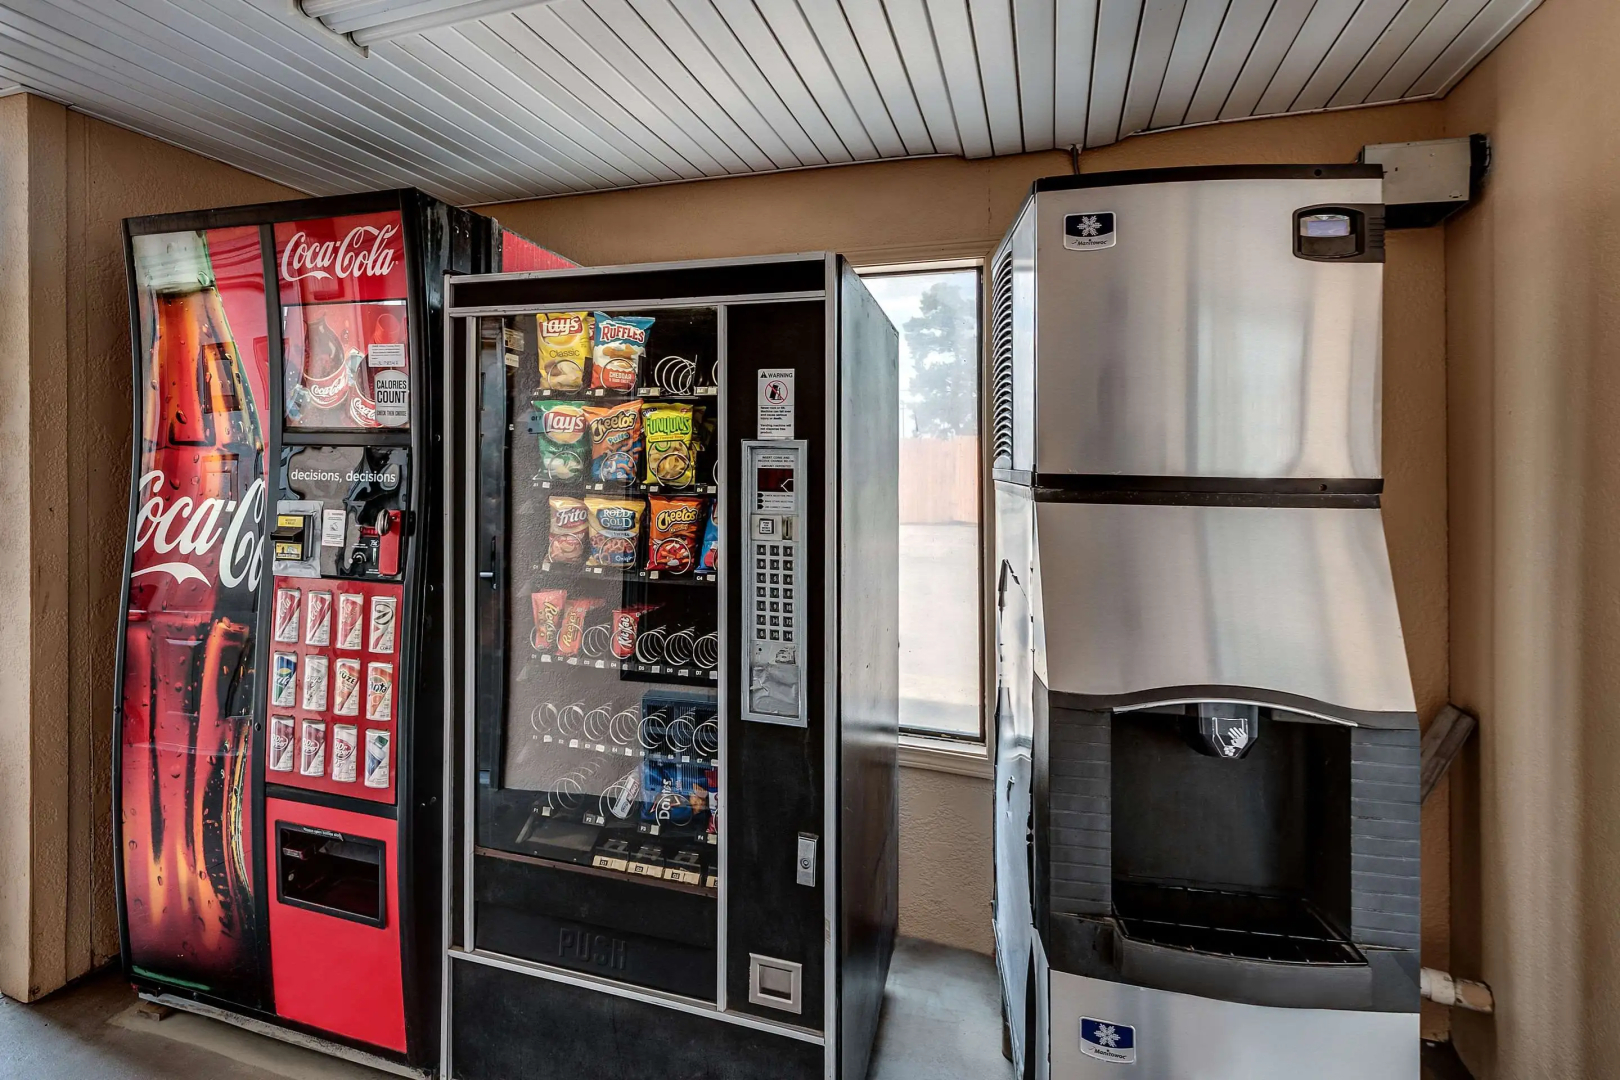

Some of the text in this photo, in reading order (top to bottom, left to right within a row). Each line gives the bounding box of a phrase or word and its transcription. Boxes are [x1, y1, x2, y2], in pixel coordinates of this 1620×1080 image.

[281, 224, 399, 282] Coca-Cola
[601, 325, 645, 343] RUFFLES
[549, 348, 580, 358] Classic
[609, 371, 632, 380] CHEDDAR
[376, 380, 407, 389] CALORIES
[377, 390, 407, 403] COUNT
[592, 410, 637, 443] Cheetos
[290, 468, 396, 483] decisions, decisions
[556, 508, 587, 526] Frito
[601, 518, 632, 528] GOLD
[657, 506, 698, 531] Cheetos
[559, 927, 627, 970] PUSH
[1094, 1049, 1127, 1059] Manitowoc
